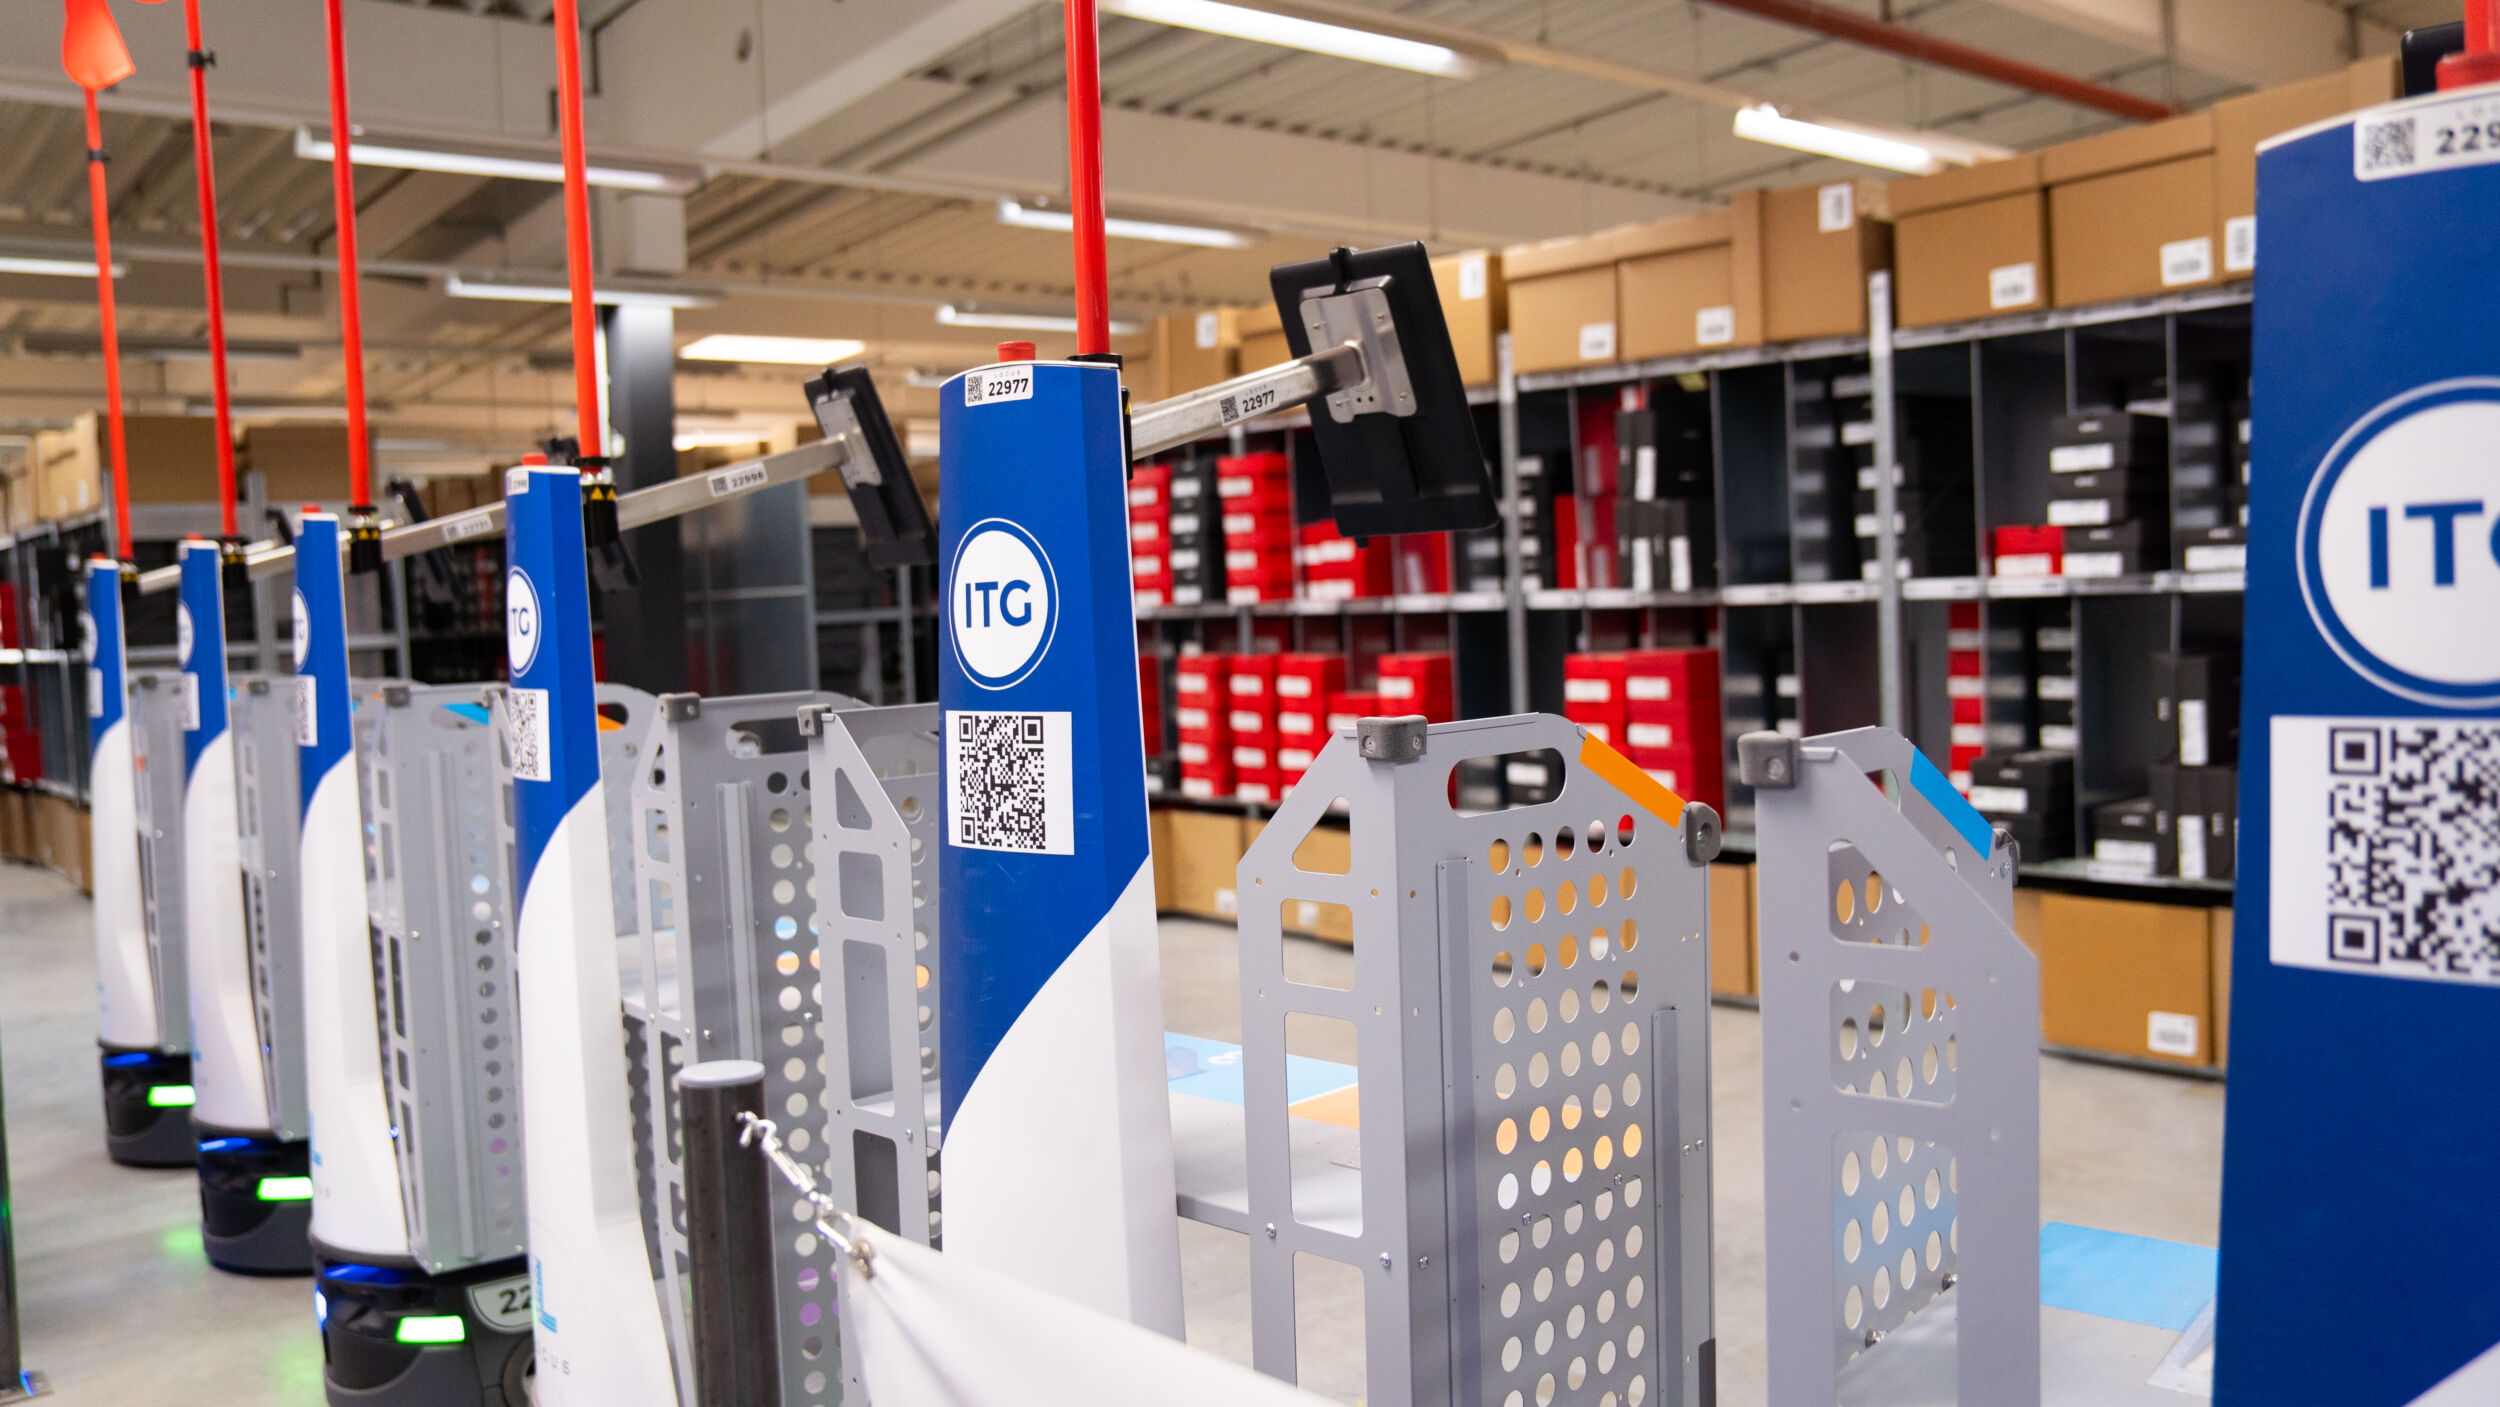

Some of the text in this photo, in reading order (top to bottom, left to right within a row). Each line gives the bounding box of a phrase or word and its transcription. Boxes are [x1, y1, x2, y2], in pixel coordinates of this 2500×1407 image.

[989, 378, 1029, 397] 22977
[1242, 390, 1275, 413] 22977
[2369, 500, 2500, 589] IT
[966, 579, 1031, 628] ITG
[510, 607, 529, 637] TG
